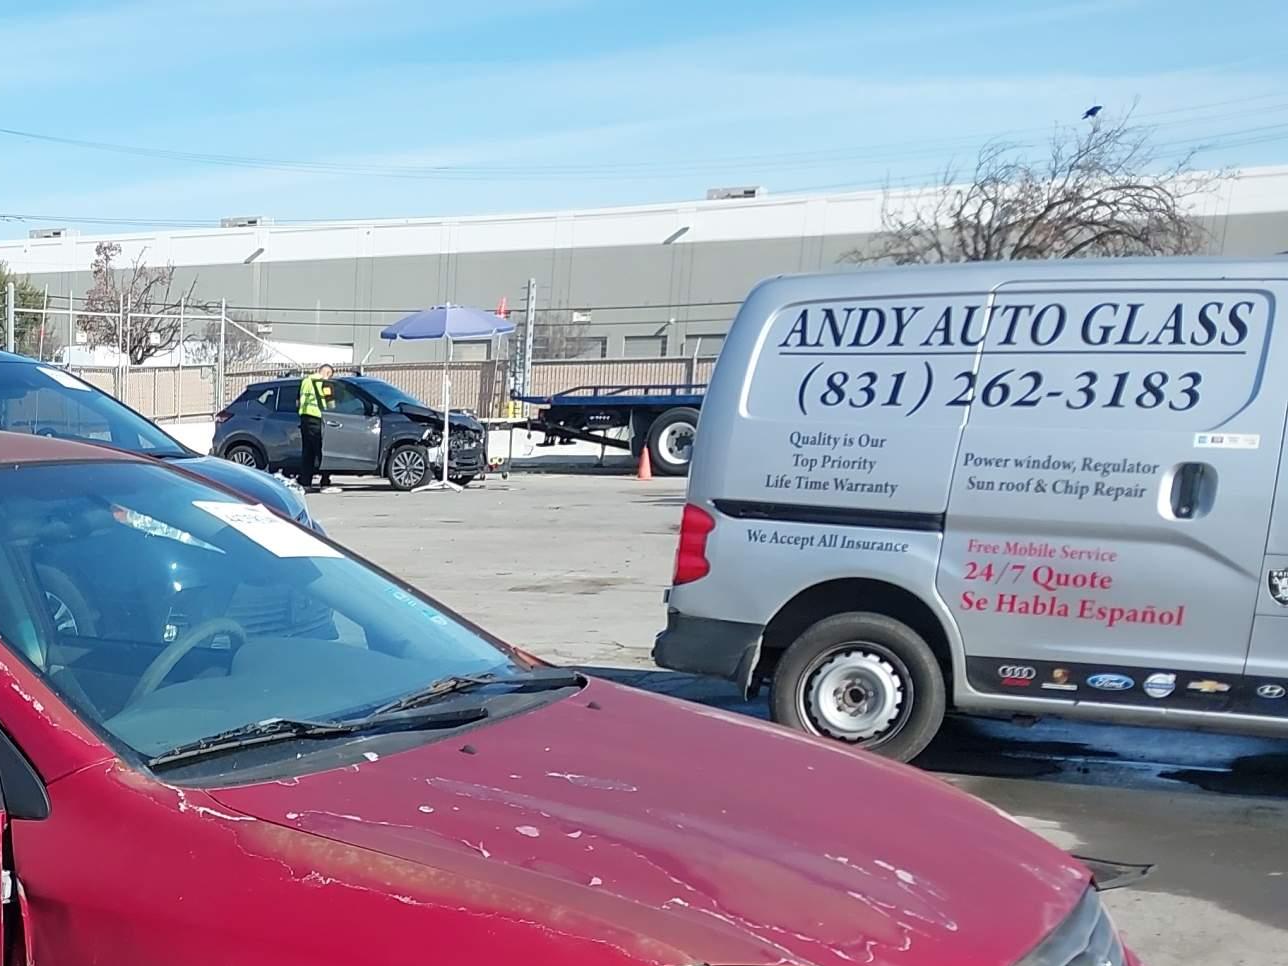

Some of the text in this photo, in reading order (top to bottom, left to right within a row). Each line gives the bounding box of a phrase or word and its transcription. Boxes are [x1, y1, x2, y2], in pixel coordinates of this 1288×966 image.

[778, 301, 1255, 348] ANDY AUTO GLASS
[798, 360, 1202, 417] (831) 262-3183
[789, 431, 887, 450] Quality is Our
[792, 453, 877, 474] Top Priority
[963, 452, 1161, 478] Power window, Regulator
[765, 474, 899, 498] Life Time Warranty
[967, 476, 1147, 502] Sun roof & Chip Repair
[746, 529, 909, 553] We Accept All Insurance
[967, 538, 1118, 562] Free Mobile Service
[963, 561, 1113, 591] 24/7 Quote
[959, 590, 1186, 628] Se Habla Español
